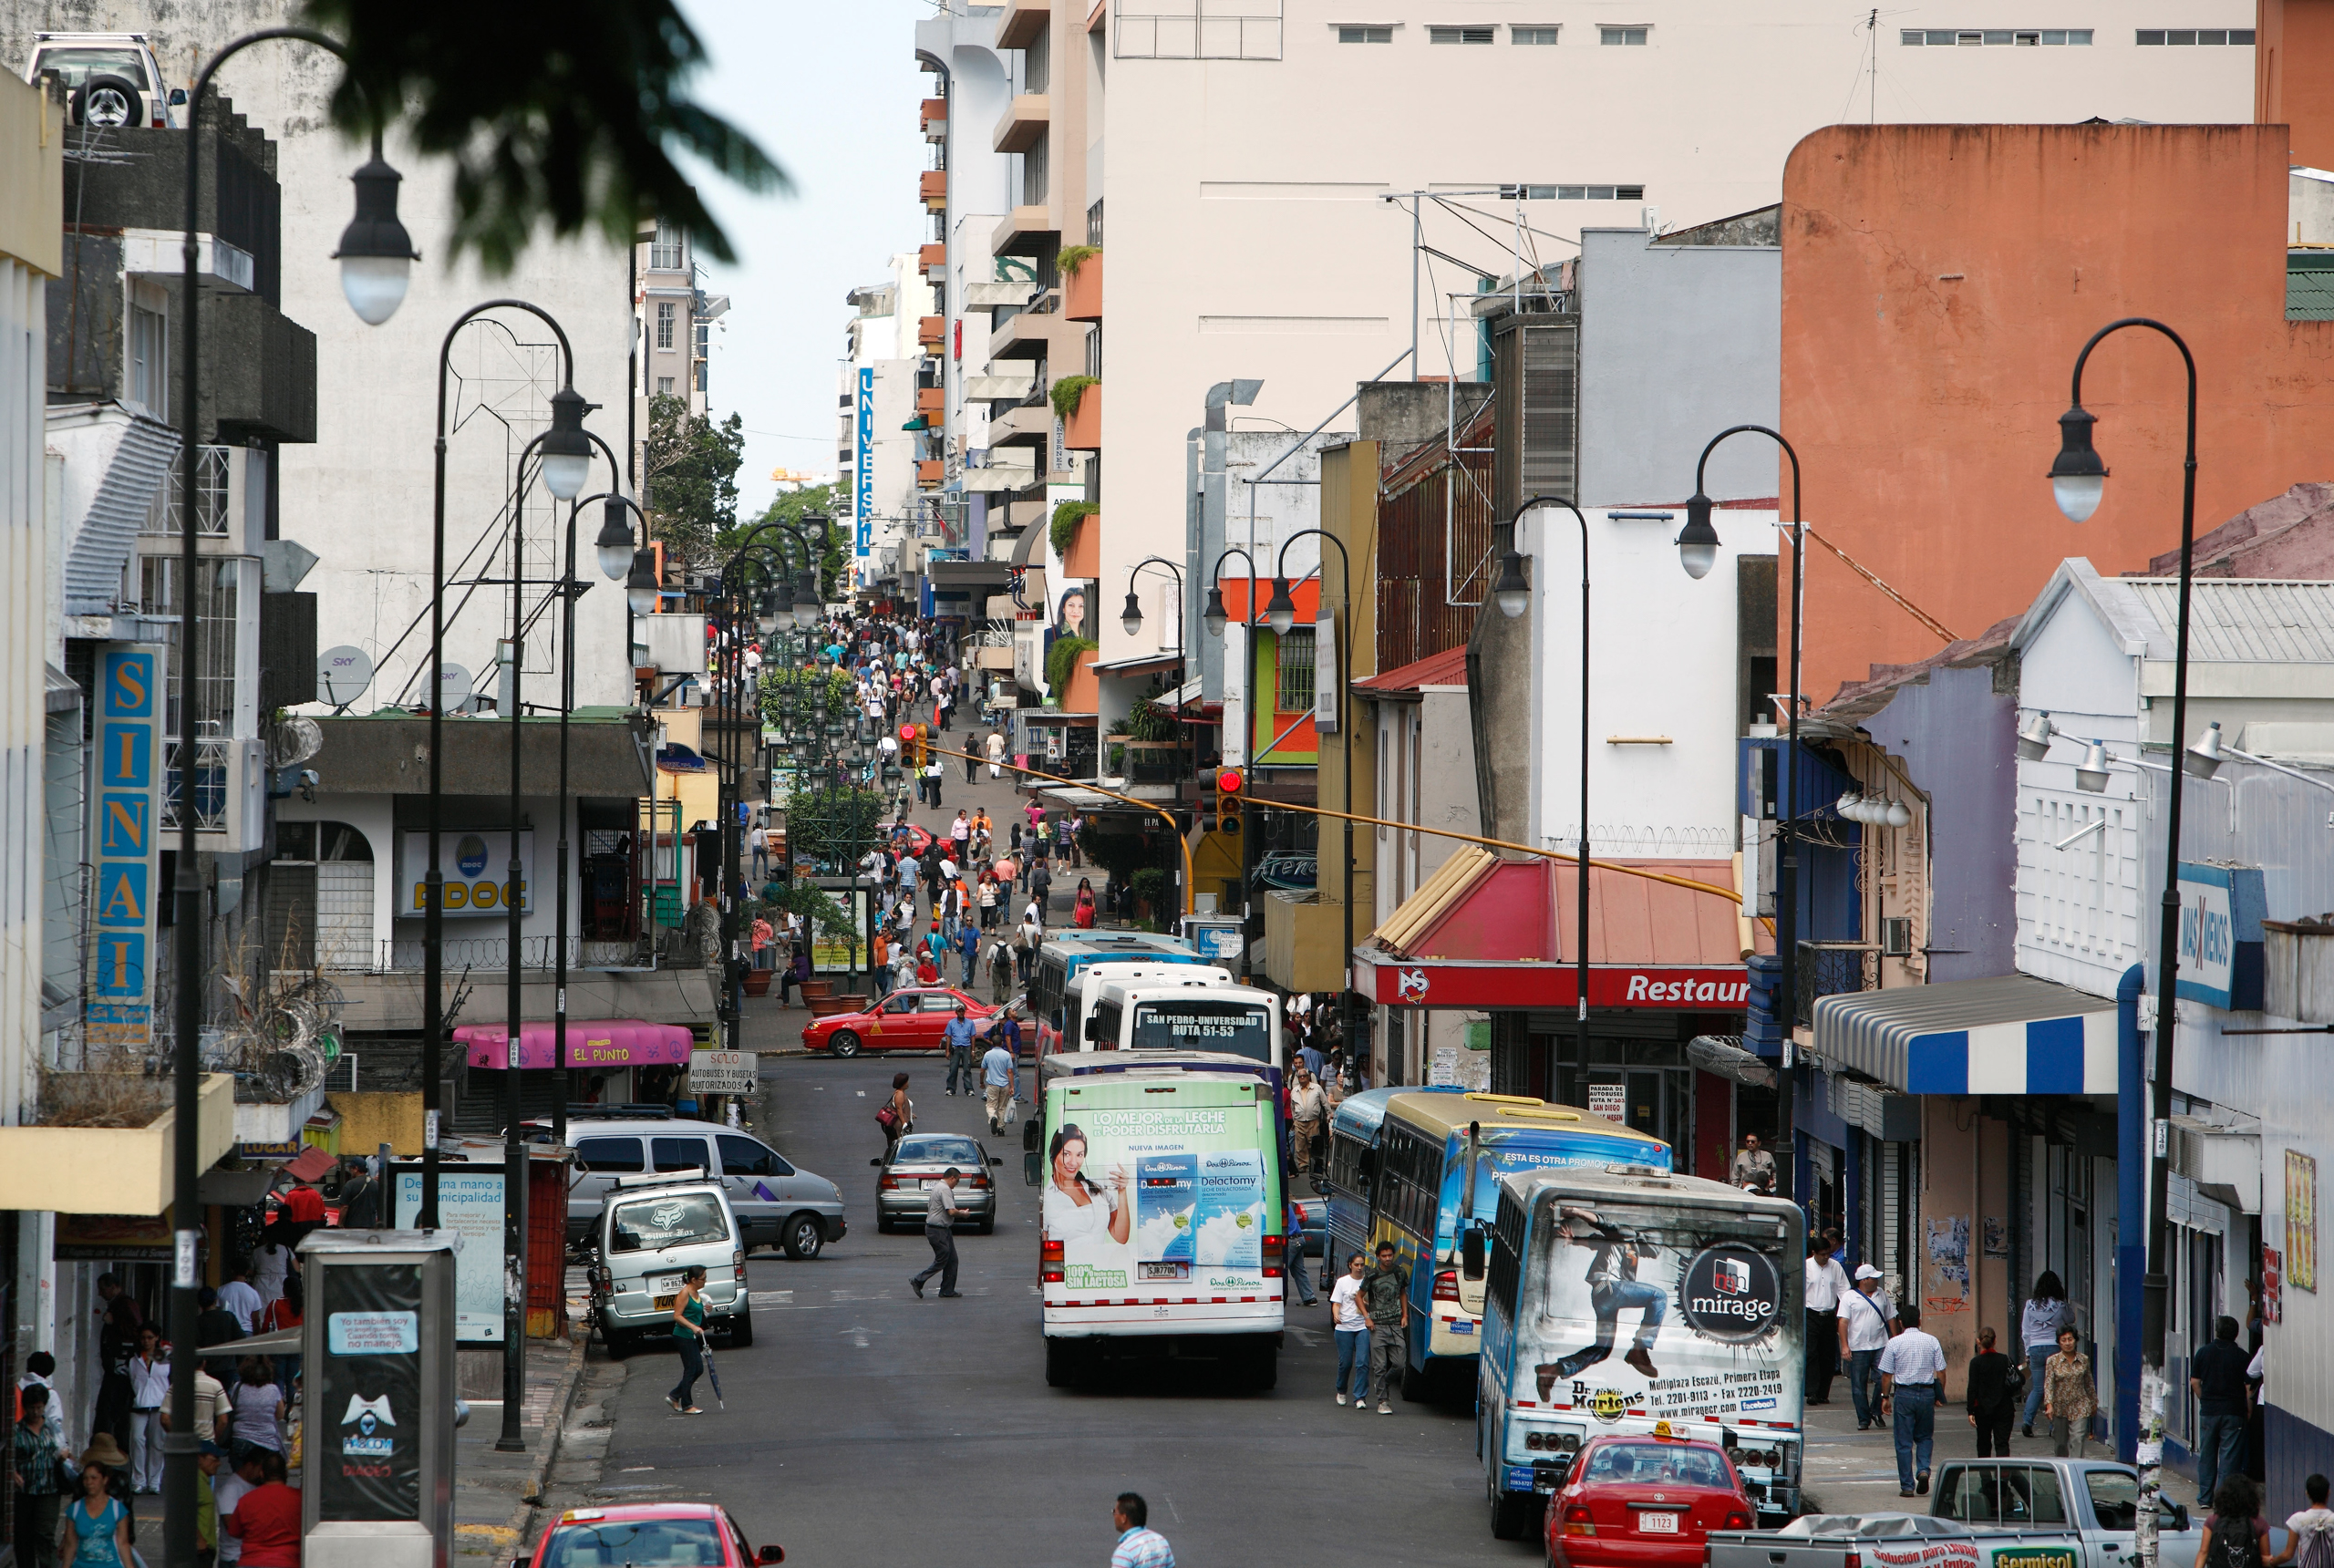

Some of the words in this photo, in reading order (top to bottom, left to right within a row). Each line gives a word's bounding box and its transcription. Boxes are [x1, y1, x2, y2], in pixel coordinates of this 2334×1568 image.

[1056, 420, 1064, 469] INTERNET
[332, 657, 356, 666] SKY
[102, 661, 147, 988] SINAI
[2204, 910, 2227, 967] MENOS
[1399, 969, 1430, 994] AS
[1147, 1015, 1165, 1024] SAN
[1167, 1015, 1258, 1026] PEDRO-UNIVERSIDAD
[1172, 1025, 1201, 1036] RUTA
[1203, 1025, 1234, 1037] 51-53
[573, 1048, 588, 1061] EL
[593, 1047, 630, 1061] PUNTO
[710, 1053, 739, 1064] SOLO
[691, 1068, 725, 1078] AUTOBUSES
[726, 1069, 730, 1078] Y
[731, 1069, 757, 1078] BUSETAS
[691, 1080, 742, 1089] AUTORIZADOS
[1605, 1104, 1621, 1112] DIEGO
[1093, 1112, 1112, 1126] LO
[1115, 1111, 1163, 1125] MEJOR
[1185, 1110, 1225, 1123] LECHE
[1102, 1124, 1143, 1136] PODER
[1146, 1123, 1225, 1136] DISFRUTARLA
[243, 1140, 298, 1154] LUGAR
[1505, 1152, 1527, 1162] ESTA
[1529, 1154, 1541, 1163] ES
[1543, 1156, 1566, 1165] OTRA
[439, 1181, 456, 1190] una
[460, 1181, 492, 1190] mano
[496, 1181, 502, 1189] a
[1201, 1176, 1256, 1187] Delactomy
[438, 1191, 501, 1205] unicipalidad
[645, 1231, 674, 1241] Silver
[676, 1228, 695, 1237] Fox
[1067, 1264, 1094, 1276] 100%
[1148, 1265, 1175, 1274] SJB7700
[1067, 1277, 1085, 1288] SIN
[1085, 1276, 1127, 1288] LACTOSA
[1691, 1294, 1772, 1322] mirage
[340, 1317, 352, 1326] Yo
[354, 1317, 390, 1326] también
[364, 1339, 402, 1349] manejo
[1648, 1377, 1689, 1391] Multiplaza
[1692, 1375, 1722, 1387] Escazú,
[1724, 1371, 1758, 1384] Primera
[1760, 1368, 1781, 1382] Etapa
[1572, 1380, 1591, 1395] Dr.
[1572, 1391, 1645, 1410] Martens
[1650, 1395, 1665, 1407] Tel.
[1668, 1391, 1709, 1405] 2201-9113
[1721, 1388, 1735, 1399] Fax
[1738, 1383, 1782, 1398] 2220-2419
[1658, 1403, 1738, 1419] www.miragecr.com
[1741, 1399, 1777, 1410] facebook
[1652, 1518, 1672, 1528] 1123
[1872, 1548, 1920, 1565] Solución
[1922, 1545, 1947, 1561] para
[1944, 1542, 1980, 1562] LAVAR
[1998, 1553, 2072, 1568] Germisol
